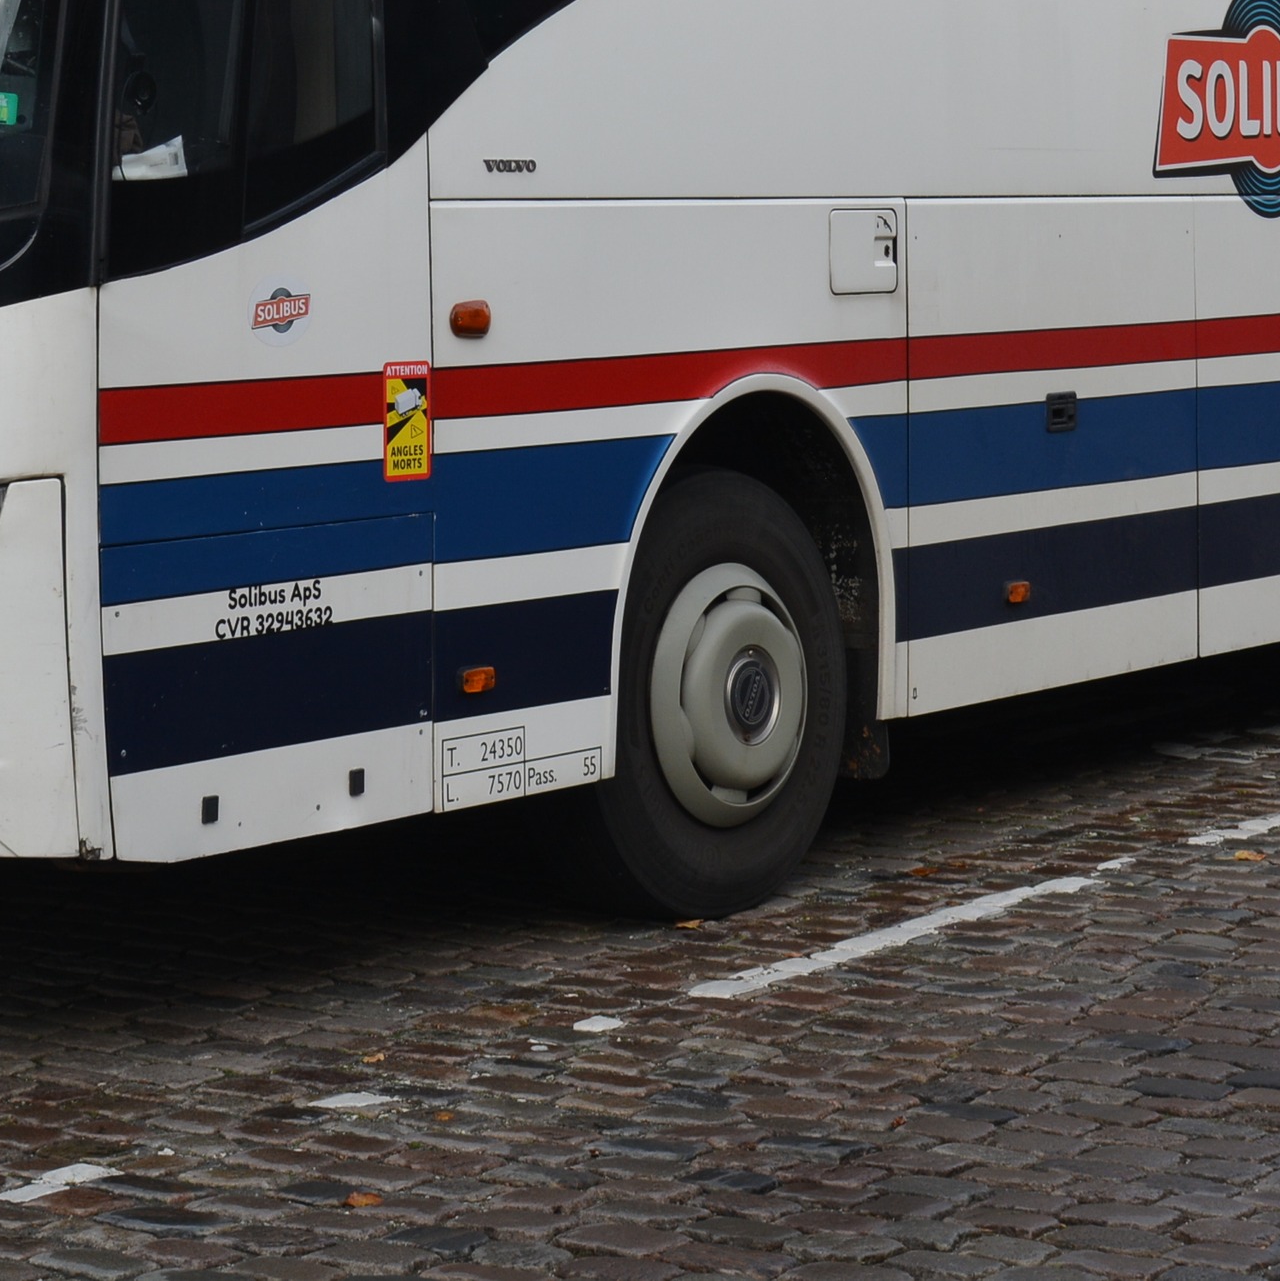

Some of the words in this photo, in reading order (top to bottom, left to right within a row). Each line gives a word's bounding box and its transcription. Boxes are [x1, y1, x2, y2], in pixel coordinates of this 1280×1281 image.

[483, 159, 537, 173] VOLVO
[257, 299, 306, 322] SOLIBUS
[386, 364, 428, 377] ATTENTION
[390, 444, 424, 457] ANGLES
[392, 458, 423, 470] MORTS
[228, 585, 286, 610] Solibus
[290, 579, 322, 607] ApS
[215, 616, 251, 640] CVR
[255, 606, 333, 634] 32943632
[744, 675, 761, 718] VOLVO
[447, 747, 461, 767] T.
[480, 735, 523, 762] 24350
[446, 783, 460, 802] L.
[488, 770, 521, 795] 7570
[528, 767, 557, 787] Pass.
[583, 755, 597, 776] 55
